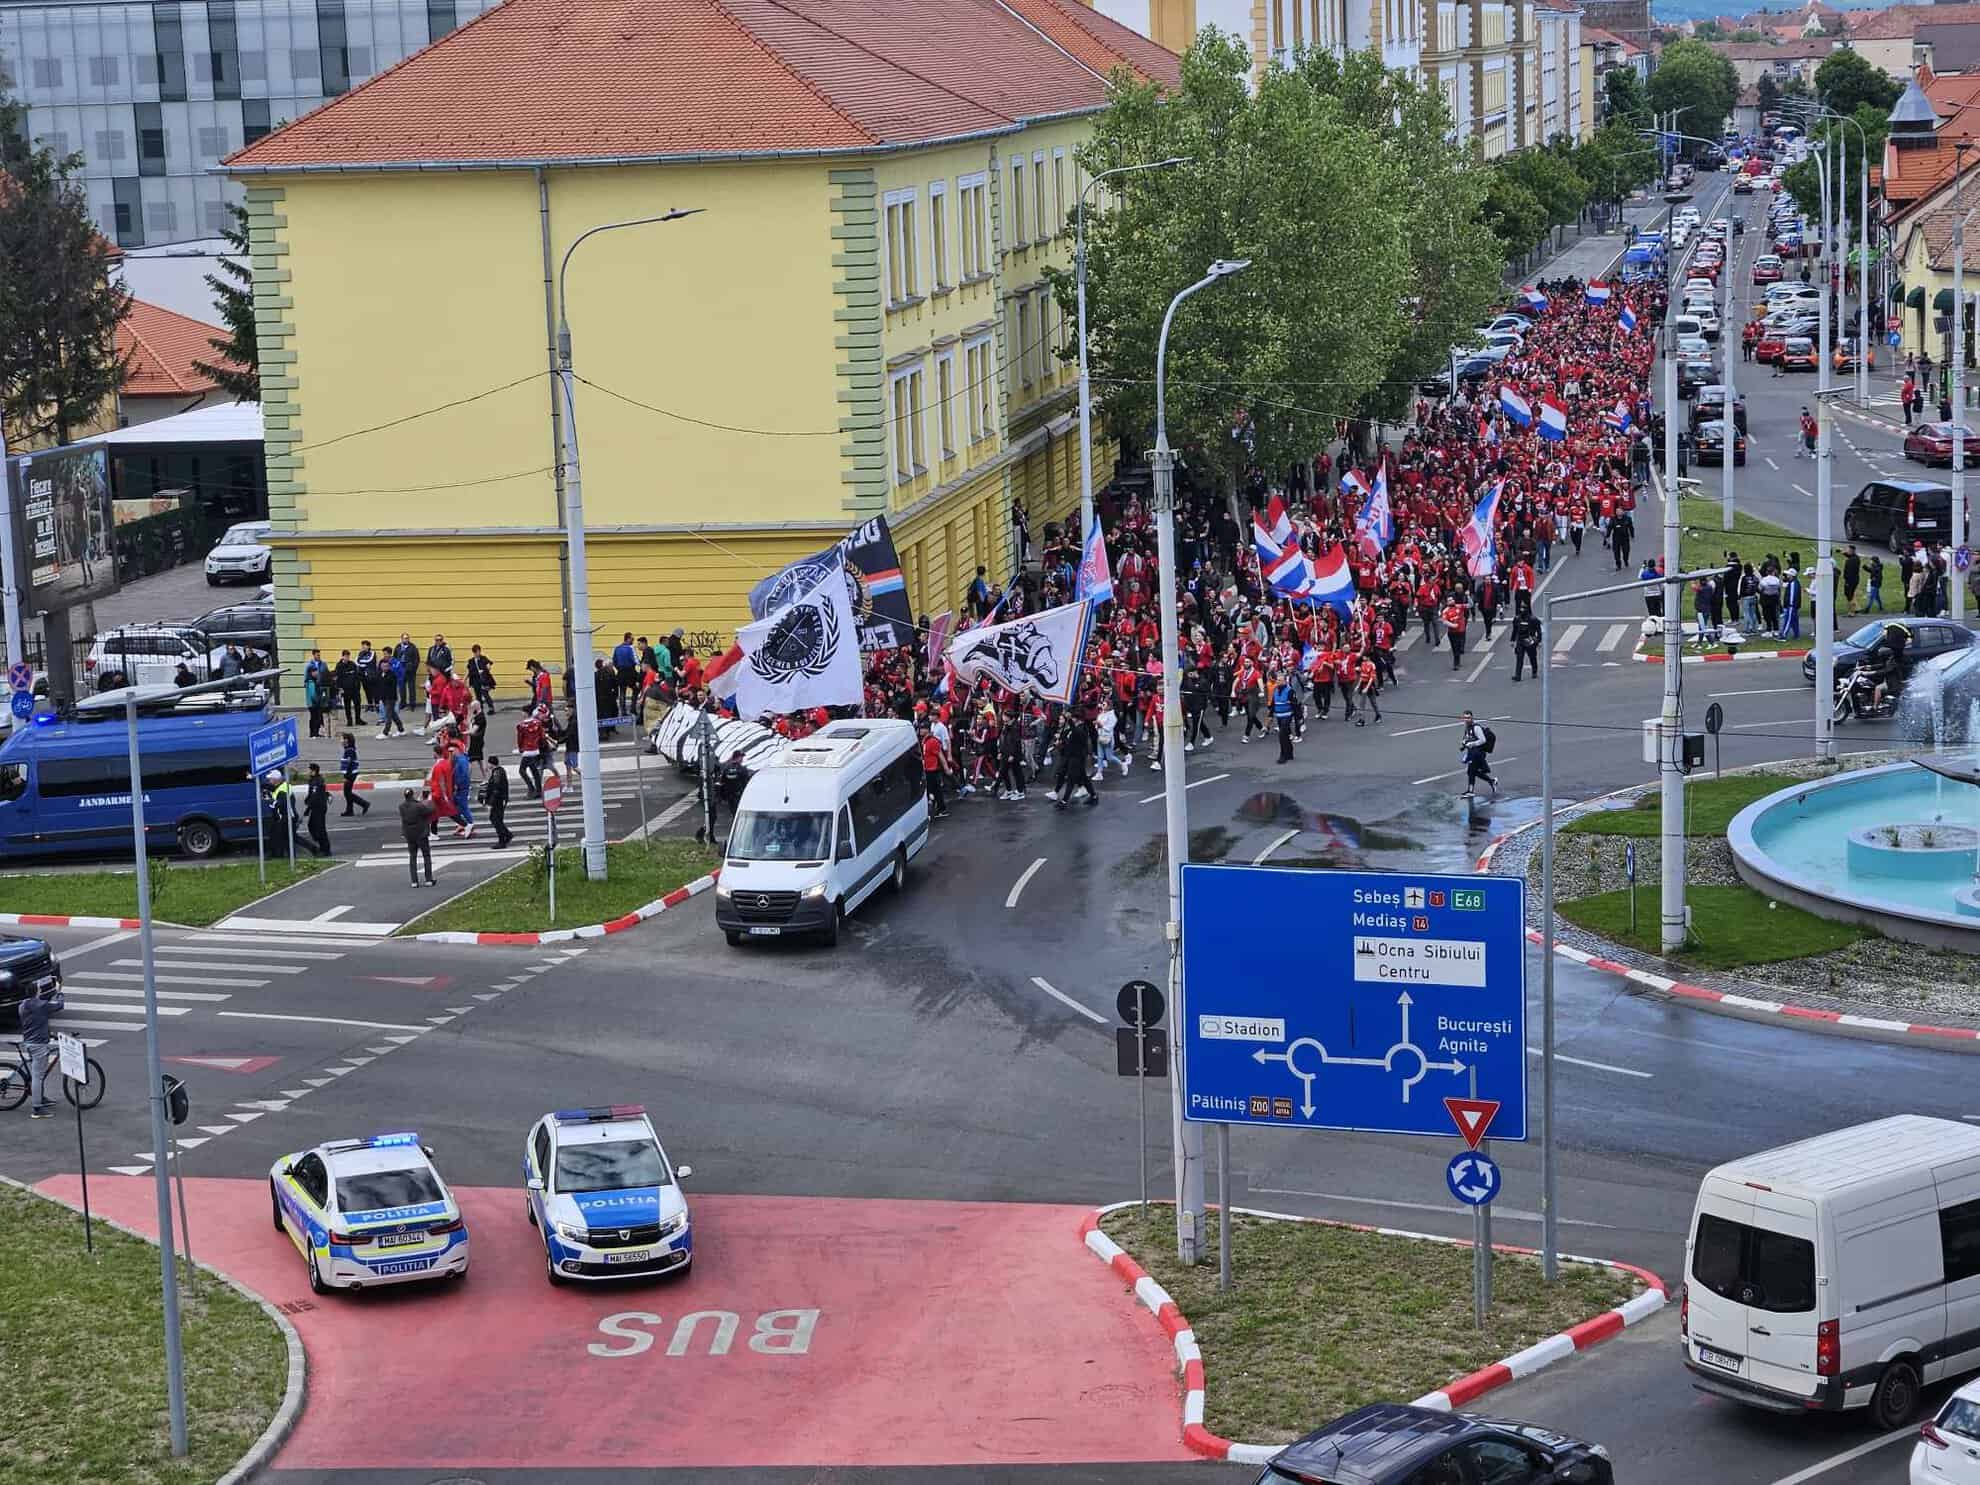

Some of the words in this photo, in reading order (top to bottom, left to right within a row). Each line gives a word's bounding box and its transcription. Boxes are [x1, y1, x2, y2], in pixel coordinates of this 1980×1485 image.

[79, 794, 150, 807] JANDARMEIA
[1353, 888, 1400, 909] Sebeș
[1455, 893, 1481, 907] E68
[1353, 912, 1407, 933] Mediaș
[1416, 919, 1426, 930] 14
[1378, 943, 1415, 957] Ocna
[1424, 944, 1481, 961] Sibiului
[1378, 964, 1430, 979] Centru
[1224, 1021, 1280, 1036] Stadion
[1438, 1016, 1512, 1038] București
[1438, 1037, 1488, 1054] Agnita
[1191, 1094, 1246, 1115] Păltiniș
[1252, 1101, 1268, 1113] ZOO
[587, 1308, 822, 1357] BUS
